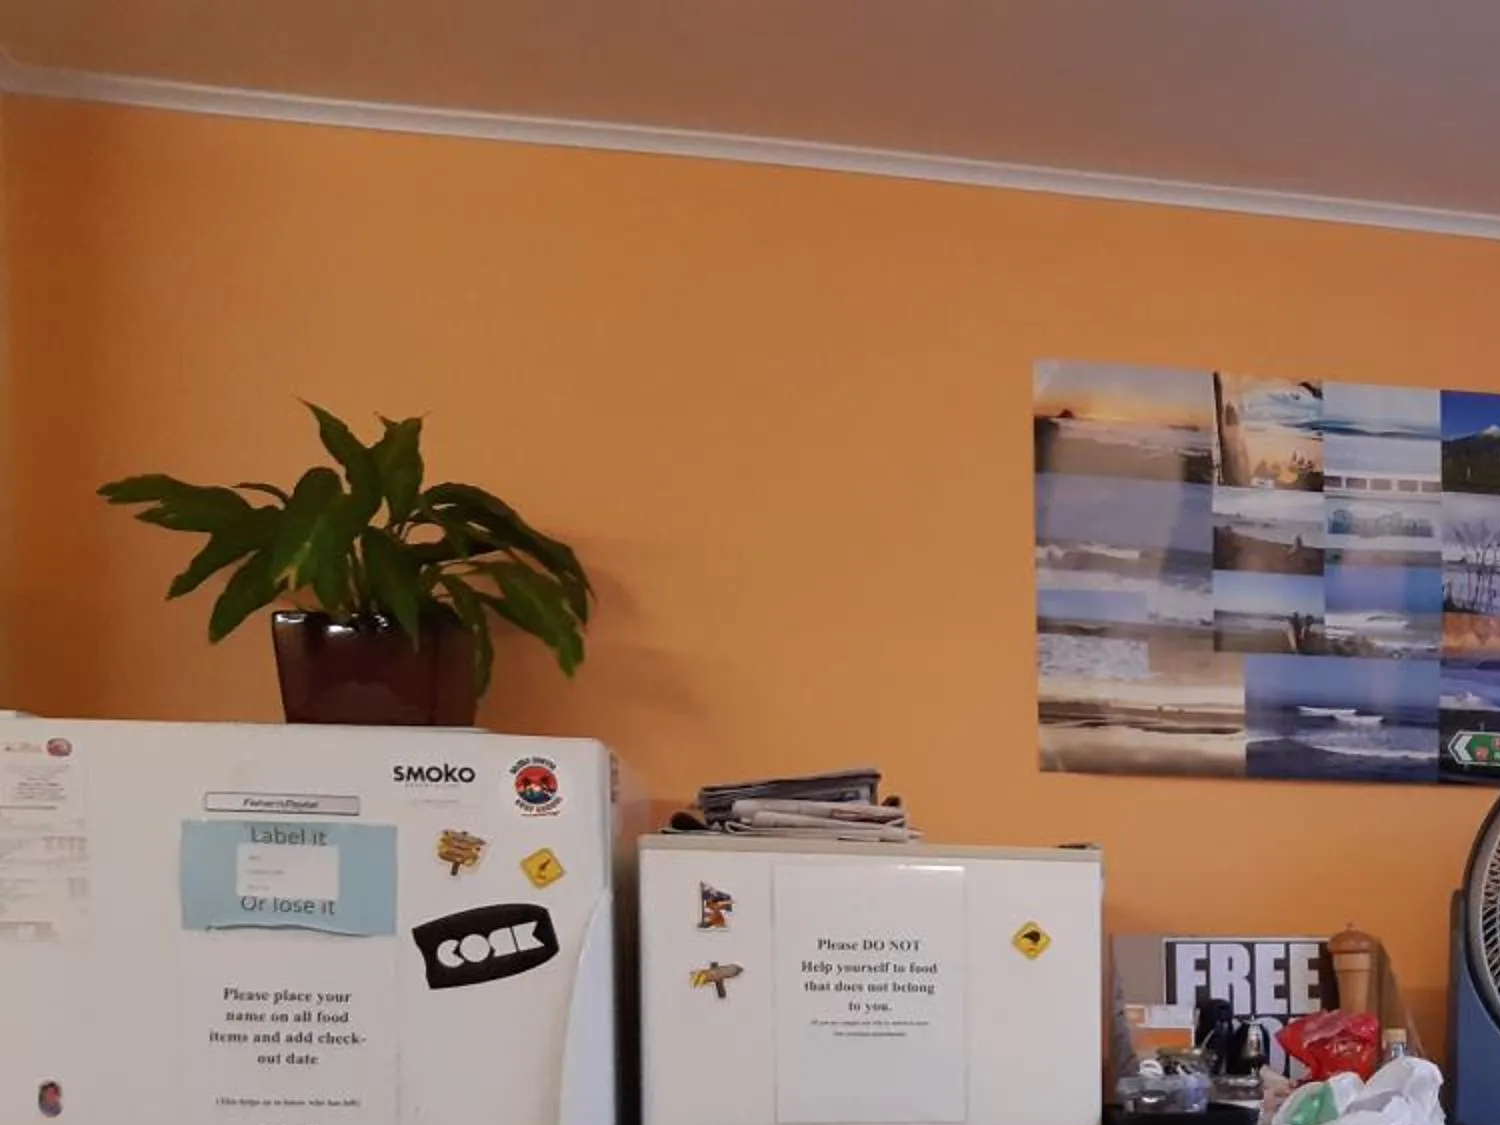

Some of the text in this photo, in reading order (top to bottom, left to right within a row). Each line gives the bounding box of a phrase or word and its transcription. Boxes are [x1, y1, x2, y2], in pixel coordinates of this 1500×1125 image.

[251, 826, 328, 846] Label it
[240, 896, 336, 915] Or lose it
[817, 938, 920, 951] Please DO NOT
[801, 960, 938, 975] Help yourself to food
[1175, 943, 1321, 1015] FREE
[804, 980, 936, 995] that does not belong
[223, 987, 352, 1004] Please place your
[848, 1001, 861, 1011] to
[225, 1010, 349, 1023] name on all food
[209, 1030, 248, 1043] items
[253, 1031, 281, 1043] and
[285, 1031, 313, 1043] add
[257, 1052, 319, 1064] out date
